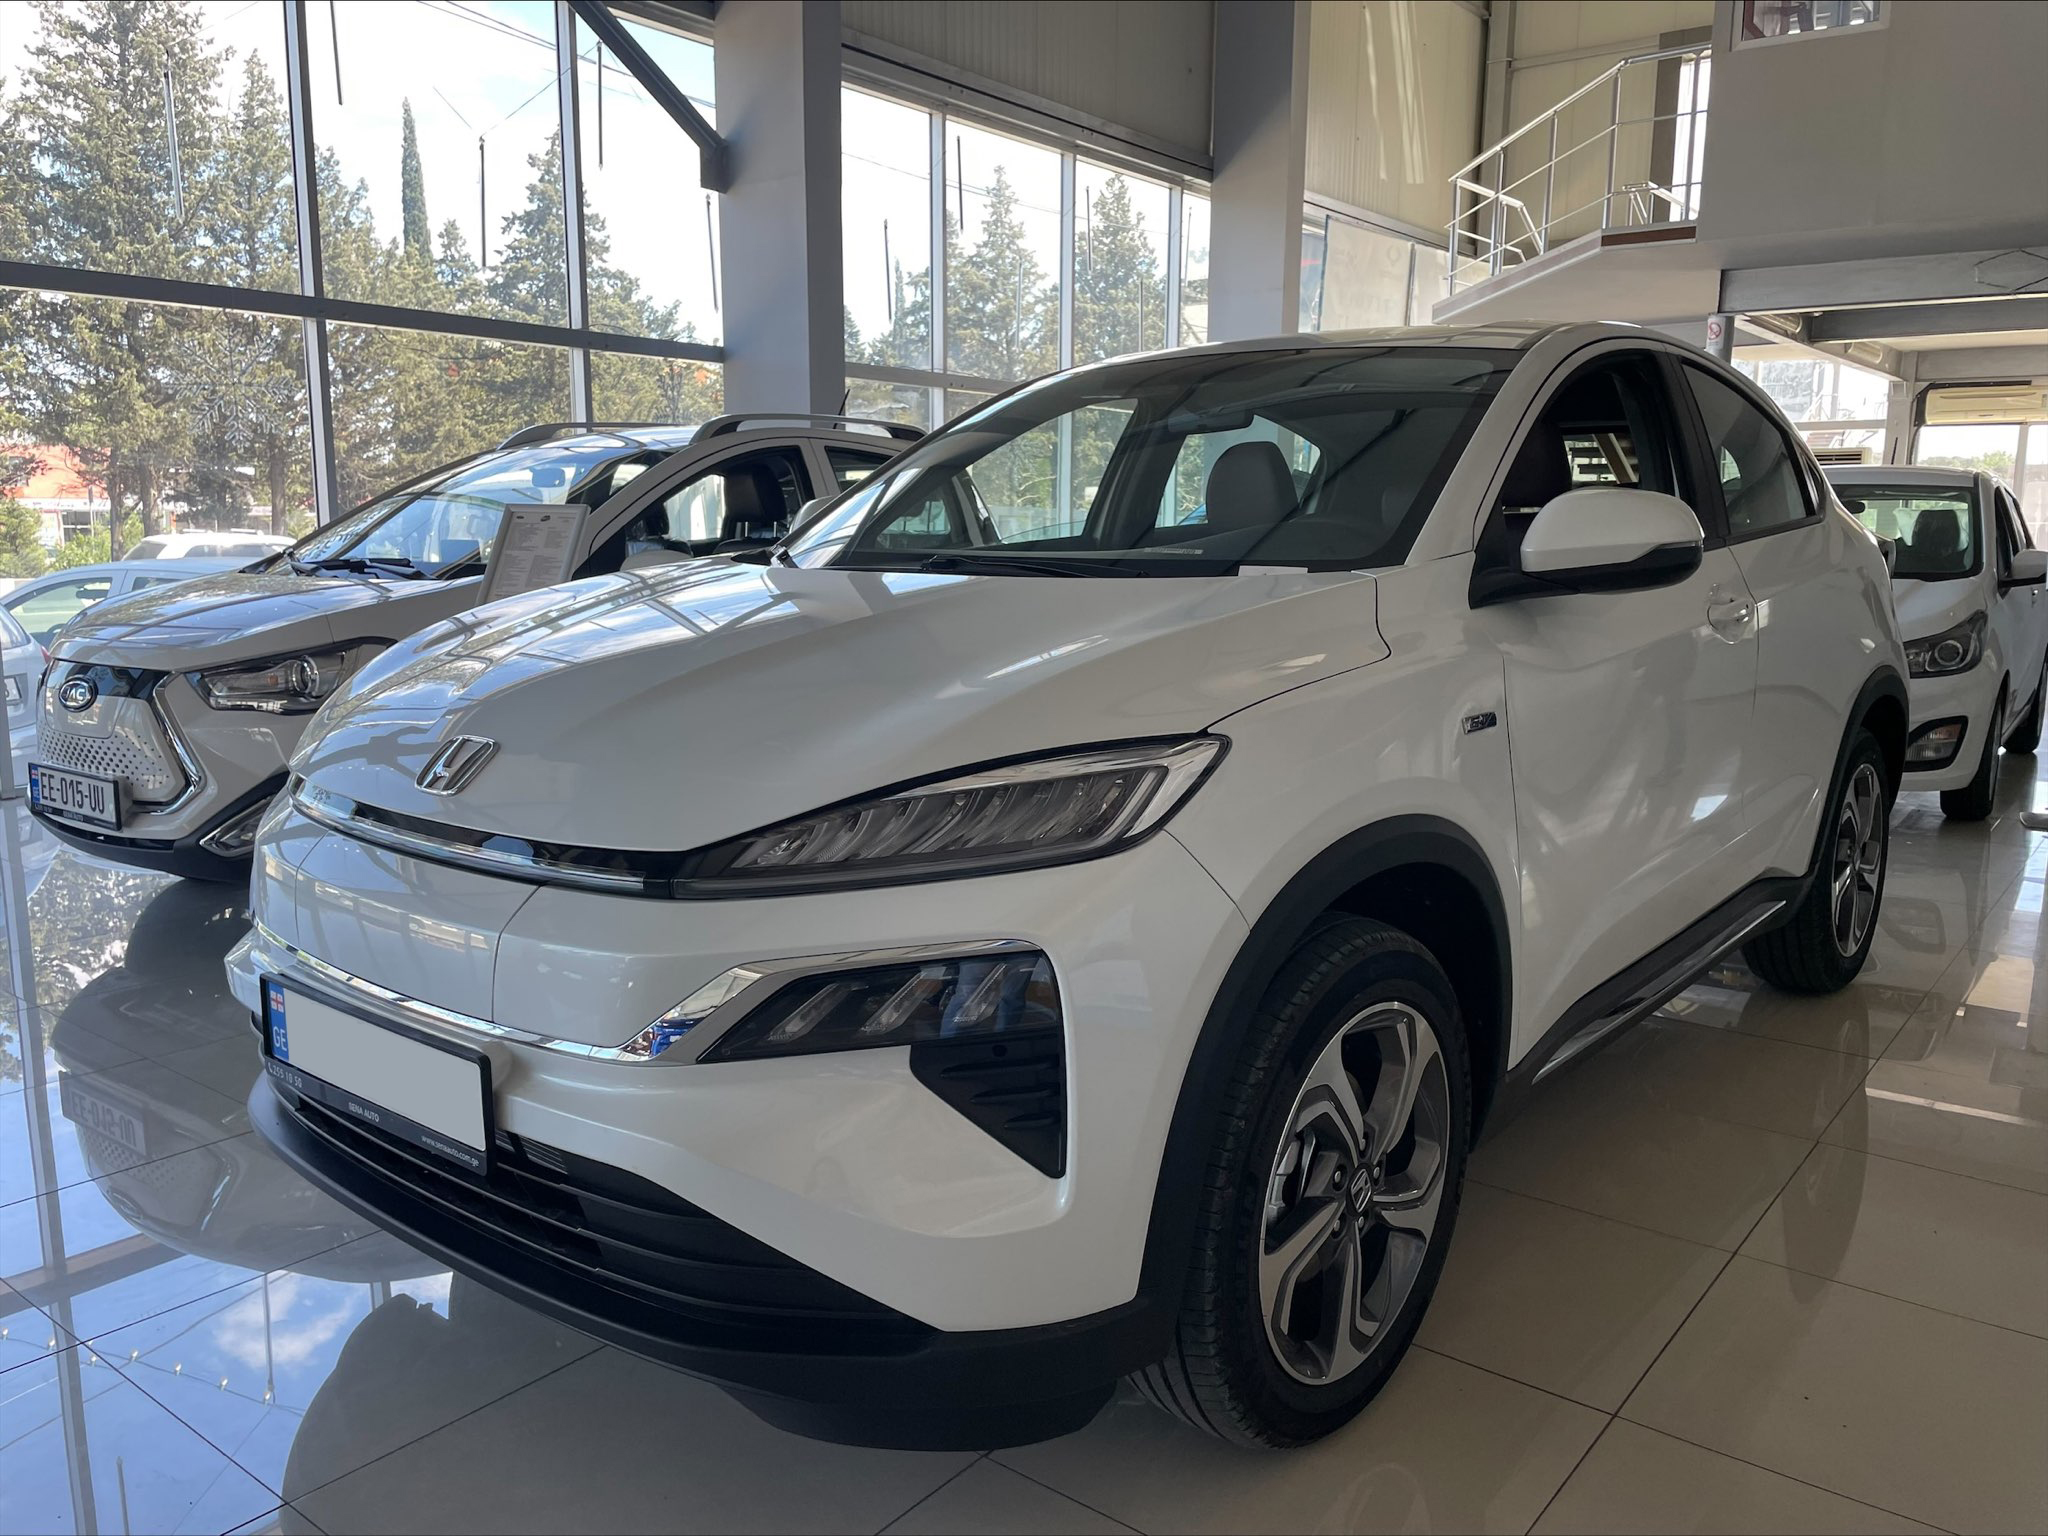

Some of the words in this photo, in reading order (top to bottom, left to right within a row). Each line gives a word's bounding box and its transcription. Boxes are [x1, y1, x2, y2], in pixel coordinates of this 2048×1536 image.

[40, 772, 105, 814] EE-015-UU
[273, 1026, 288, 1051] GE
[348, 1101, 364, 1116] SENA
[363, 1109, 380, 1123] AUTO
